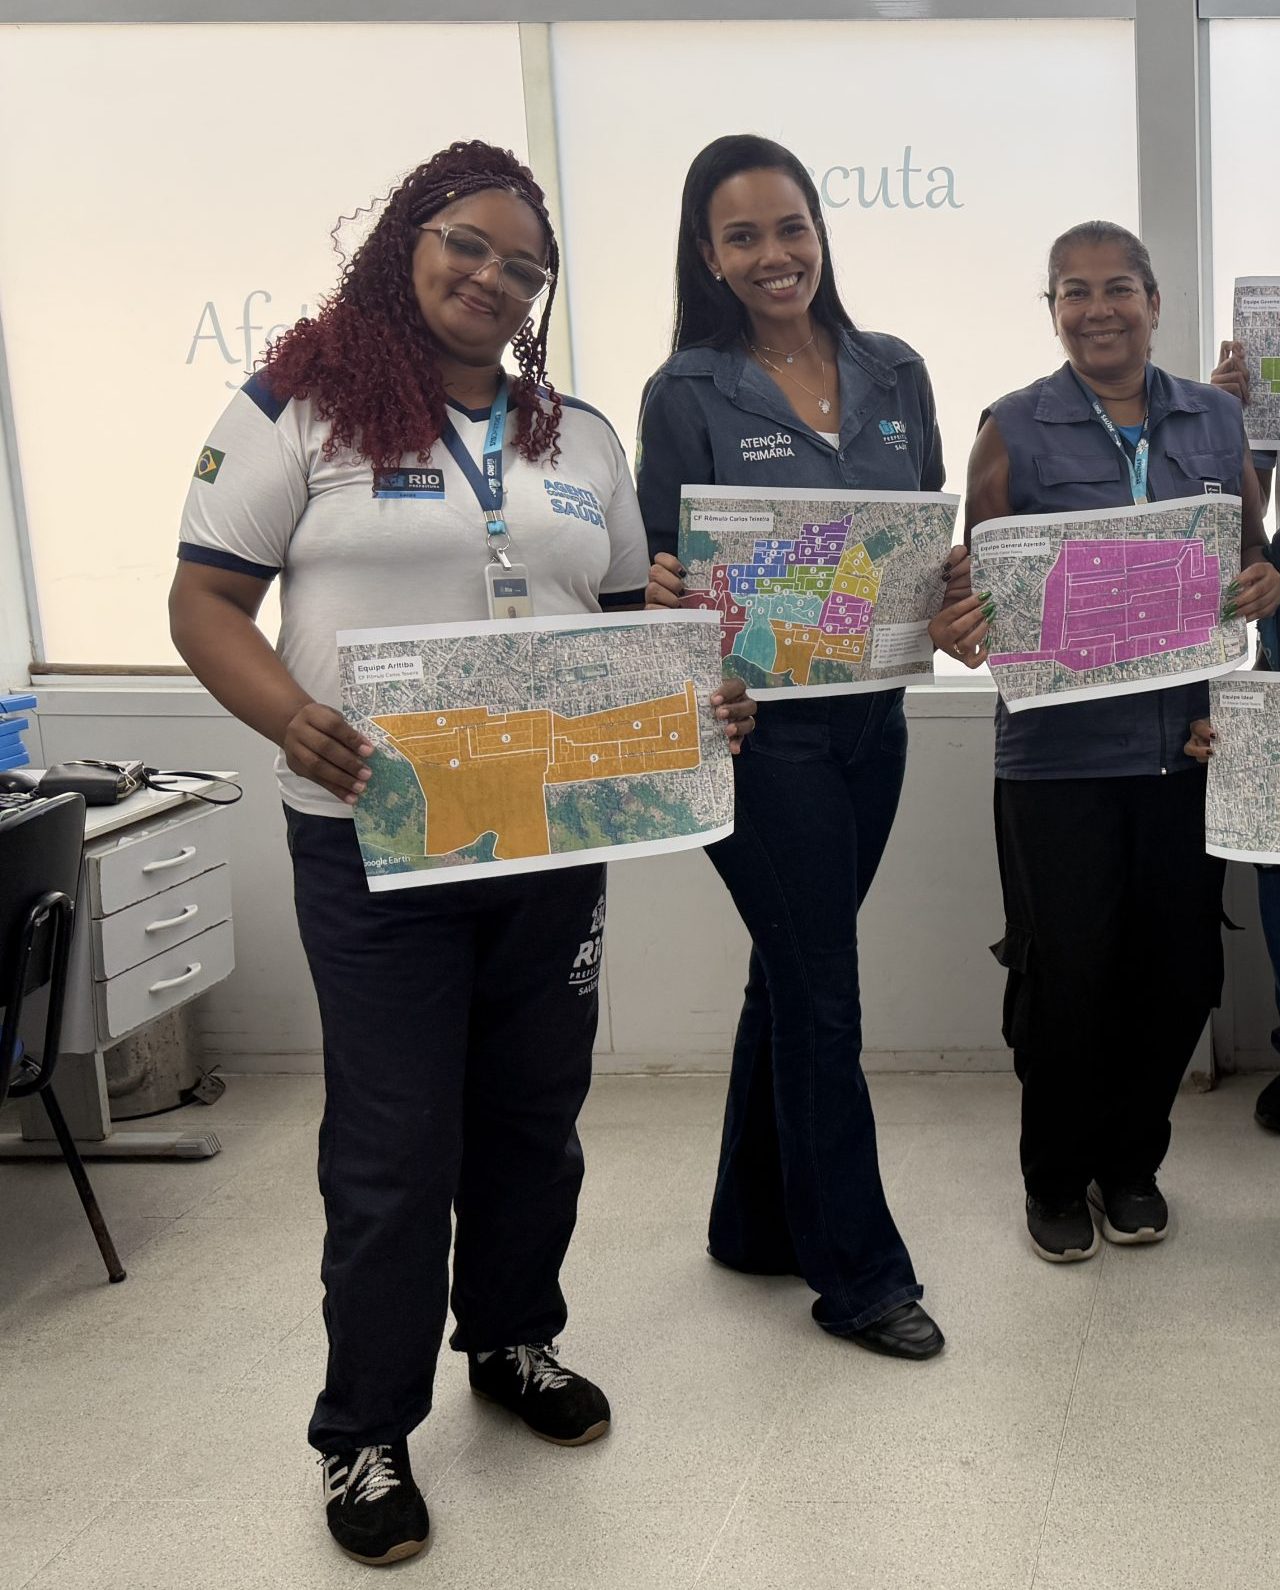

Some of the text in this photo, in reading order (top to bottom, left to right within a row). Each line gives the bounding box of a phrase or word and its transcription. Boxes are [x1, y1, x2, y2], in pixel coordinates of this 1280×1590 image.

[807, 145, 965, 209] cuta
[740, 432, 792, 449] ATENÇÃO
[742, 447, 796, 462] PRIMÁRIA
[408, 474, 440, 485] RIO
[358, 664, 386, 673] Equipe
[388, 855, 411, 864] Earth
